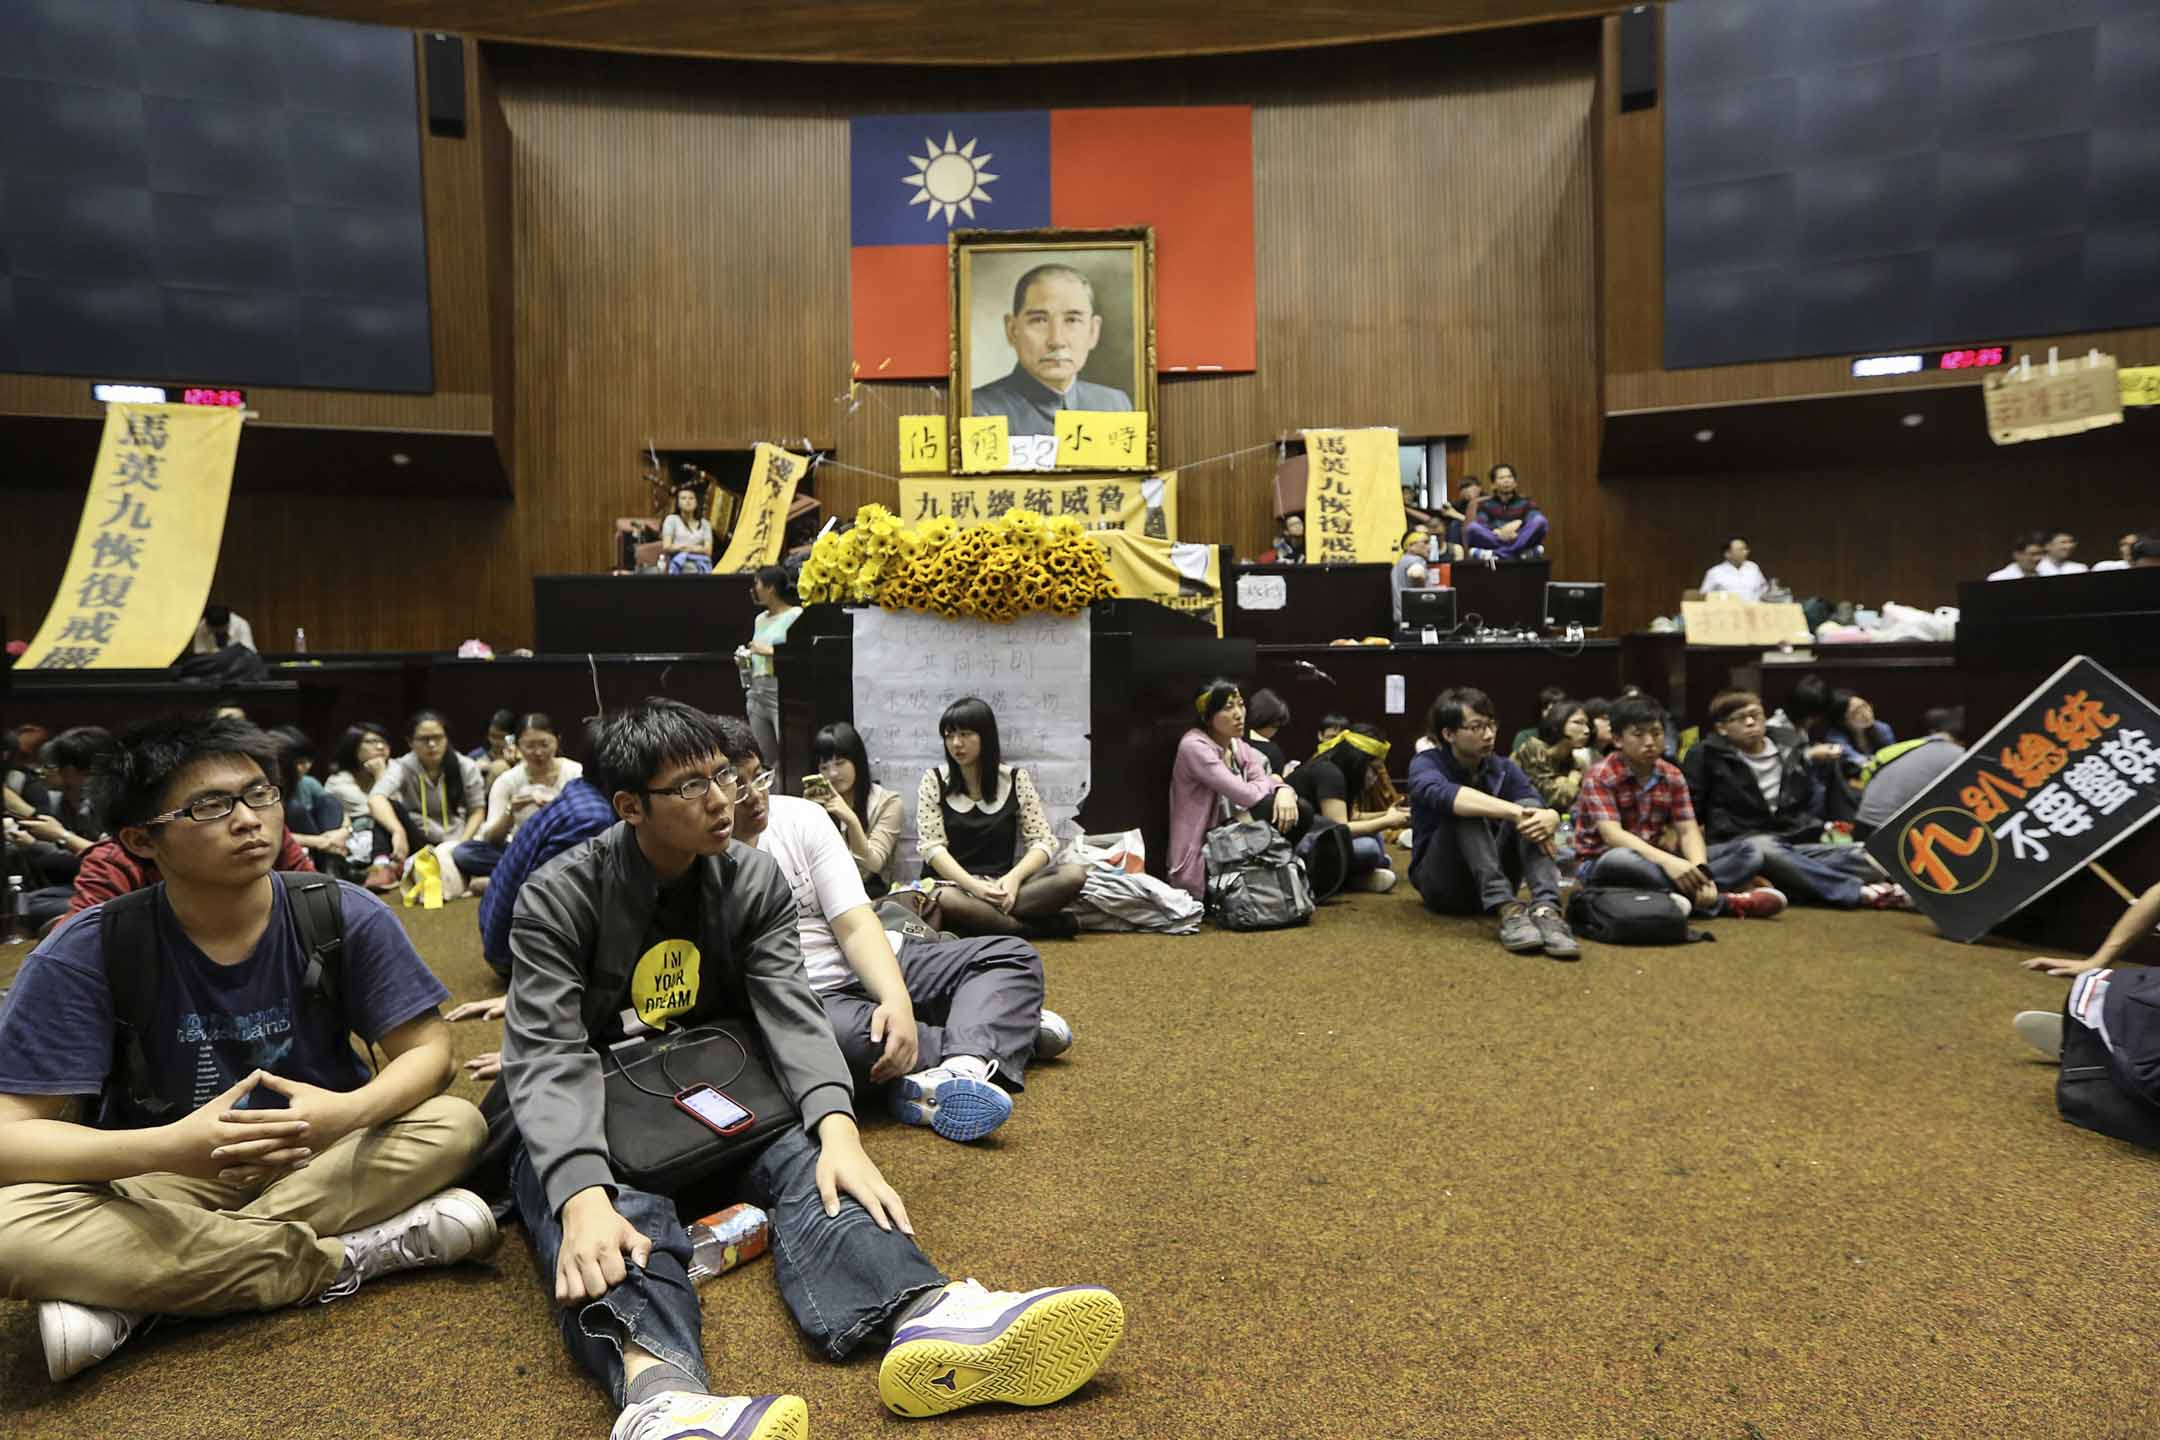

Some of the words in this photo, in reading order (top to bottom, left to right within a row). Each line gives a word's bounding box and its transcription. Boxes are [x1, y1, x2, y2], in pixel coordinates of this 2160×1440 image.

[915, 485, 1125, 520] 九趴總統威脅
[1909, 690, 2120, 892] 九趴總統
[1994, 728, 2160, 862] 不要蠻幹
[655, 971, 685, 993] YOUR
[645, 990, 692, 1014] DREAM
